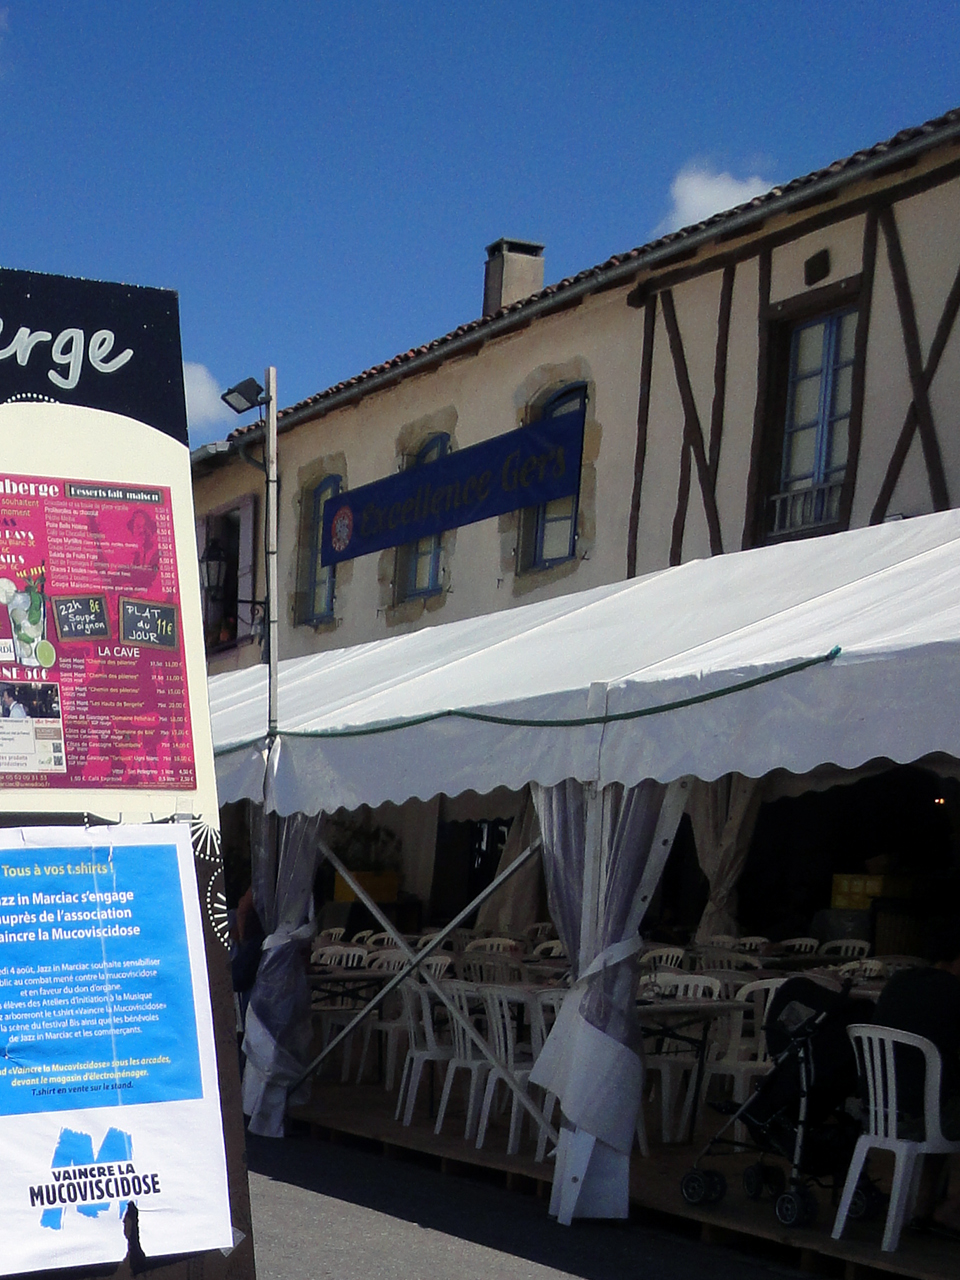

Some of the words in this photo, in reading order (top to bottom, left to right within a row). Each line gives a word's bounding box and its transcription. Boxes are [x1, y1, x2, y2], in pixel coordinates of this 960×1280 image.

[108, 489, 123, 499] fait
[126, 491, 159, 501] maison
[360, 470, 493, 537] Excellence
[501, 445, 566, 492] Gers
[59, 600, 82, 615] 22h
[126, 605, 161, 619] PLAT
[68, 613, 96, 622] Soupe
[71, 621, 105, 634] l'oignon
[137, 620, 150, 629] du
[157, 619, 173, 635] 11€
[128, 630, 159, 644] JOUR
[98, 646, 111, 656] LA
[113, 646, 140, 658] CAVE
[1, 863, 32, 878] Tous
[34, 863, 41, 876] à
[43, 865, 64, 876] vos
[67, 861, 108, 875] t.shirts
[17, 891, 29, 906] in
[32, 890, 79, 905] Marciac
[81, 888, 134, 905] s'engage
[39, 908, 55, 923] de
[57, 906, 132, 922] l'association
[38, 927, 49, 942] la
[52, 924, 141, 941] Mucoviscidose
[10, 966, 15, 974] 4
[36, 964, 52, 973] Jazz
[53, 963, 60, 972] in
[61, 963, 89, 971] Marciac
[91, 961, 121, 969] souhaite
[123, 958, 161, 967] sensibiliser
[24, 976, 52, 985] combat
[53, 974, 73, 983] mené
[98, 972, 105, 980] la
[106, 969, 158, 979] mucoviscidose
[20, 989, 28, 997] et
[39, 986, 62, 996] faveur
[63, 985, 73, 994] du
[74, 984, 89, 993] don
[3, 1000, 26, 1009] élèves
[27, 999, 40, 1008] des
[42, 998, 69, 1007] Ateliers
[115, 993, 122, 1001] la
[123, 992, 153, 1001] Musique
[4, 1011, 44, 1020] arboreront
[44, 1009, 51, 1018] le
[105, 1005, 112, 1013] la
[0, 1023, 7, 1032] la
[8, 1022, 29, 1032] scène
[31, 1021, 41, 1030] du
[42, 1019, 68, 1029] festival
[69, 1018, 80, 1027] Bis
[81, 1017, 97, 1026] ainsi
[98, 1018, 112, 1027] que
[113, 1016, 123, 1024] les
[124, 1014, 159, 1023] bénévoles
[9, 1034, 19, 1043] de
[20, 1033, 35, 1042] Jazz
[36, 1032, 44, 1040] in
[45, 1031, 73, 1040] Marciac
[83, 1028, 93, 1037] les
[43, 1064, 51, 1072] la
[111, 1059, 128, 1068] sous
[129, 1057, 140, 1066] les
[11, 1077, 39, 1087] devant
[40, 1075, 48, 1084] le
[49, 1074, 82, 1084] magasin
[68, 1085, 89, 1093] vente
[103, 1082, 109, 1090] le
[52, 1166, 115, 1182] VAINCRE
[118, 1163, 135, 1175] LA
[29, 1173, 161, 1207] MUCOVISCIDOSE
